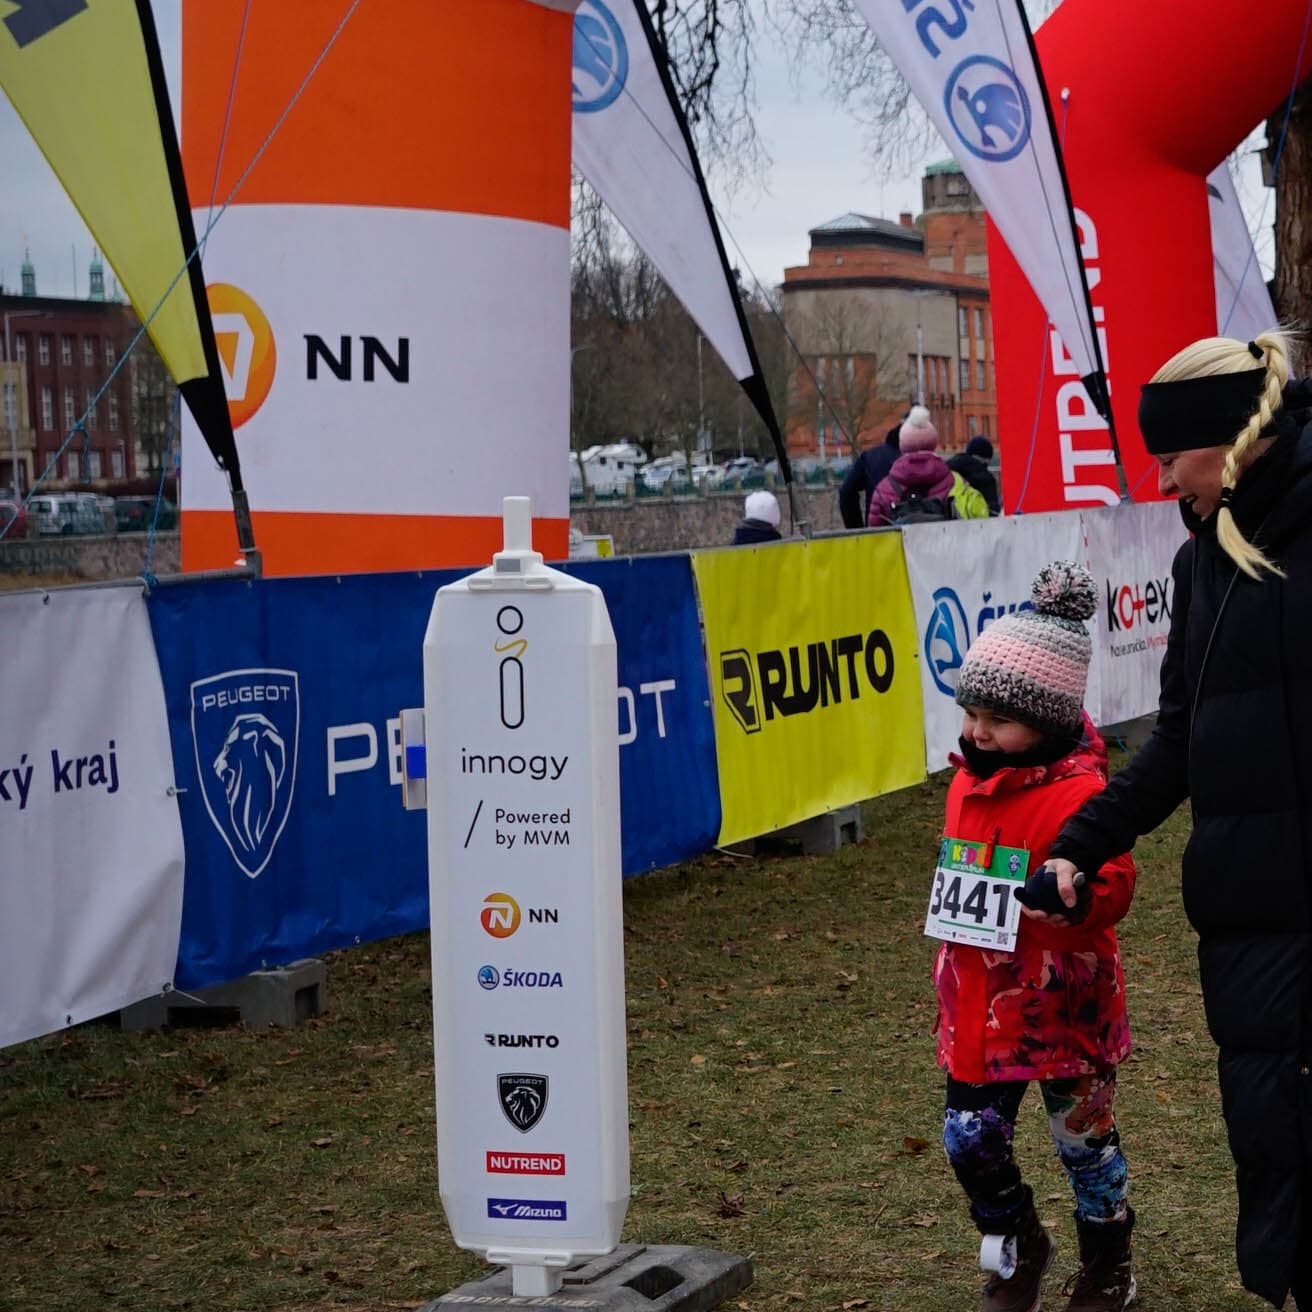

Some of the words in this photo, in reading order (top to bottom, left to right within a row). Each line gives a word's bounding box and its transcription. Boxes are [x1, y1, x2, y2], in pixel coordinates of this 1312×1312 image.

[303, 333, 409, 383] NN
[758, 629, 895, 722] RUNTO
[202, 686, 290, 713] PEUGEOT
[51, 739, 119, 794] kraj
[462, 747, 568, 780] innogy
[496, 808, 571, 825] Powered
[496, 830, 515, 848] by
[524, 831, 570, 845] MVM
[931, 871, 1011, 928] 3441
[529, 908, 559, 924] NN
[503, 968, 563, 988] ŠKODA
[498, 1035, 560, 1049] RUNTO
[490, 1156, 562, 1171] NUTREND
